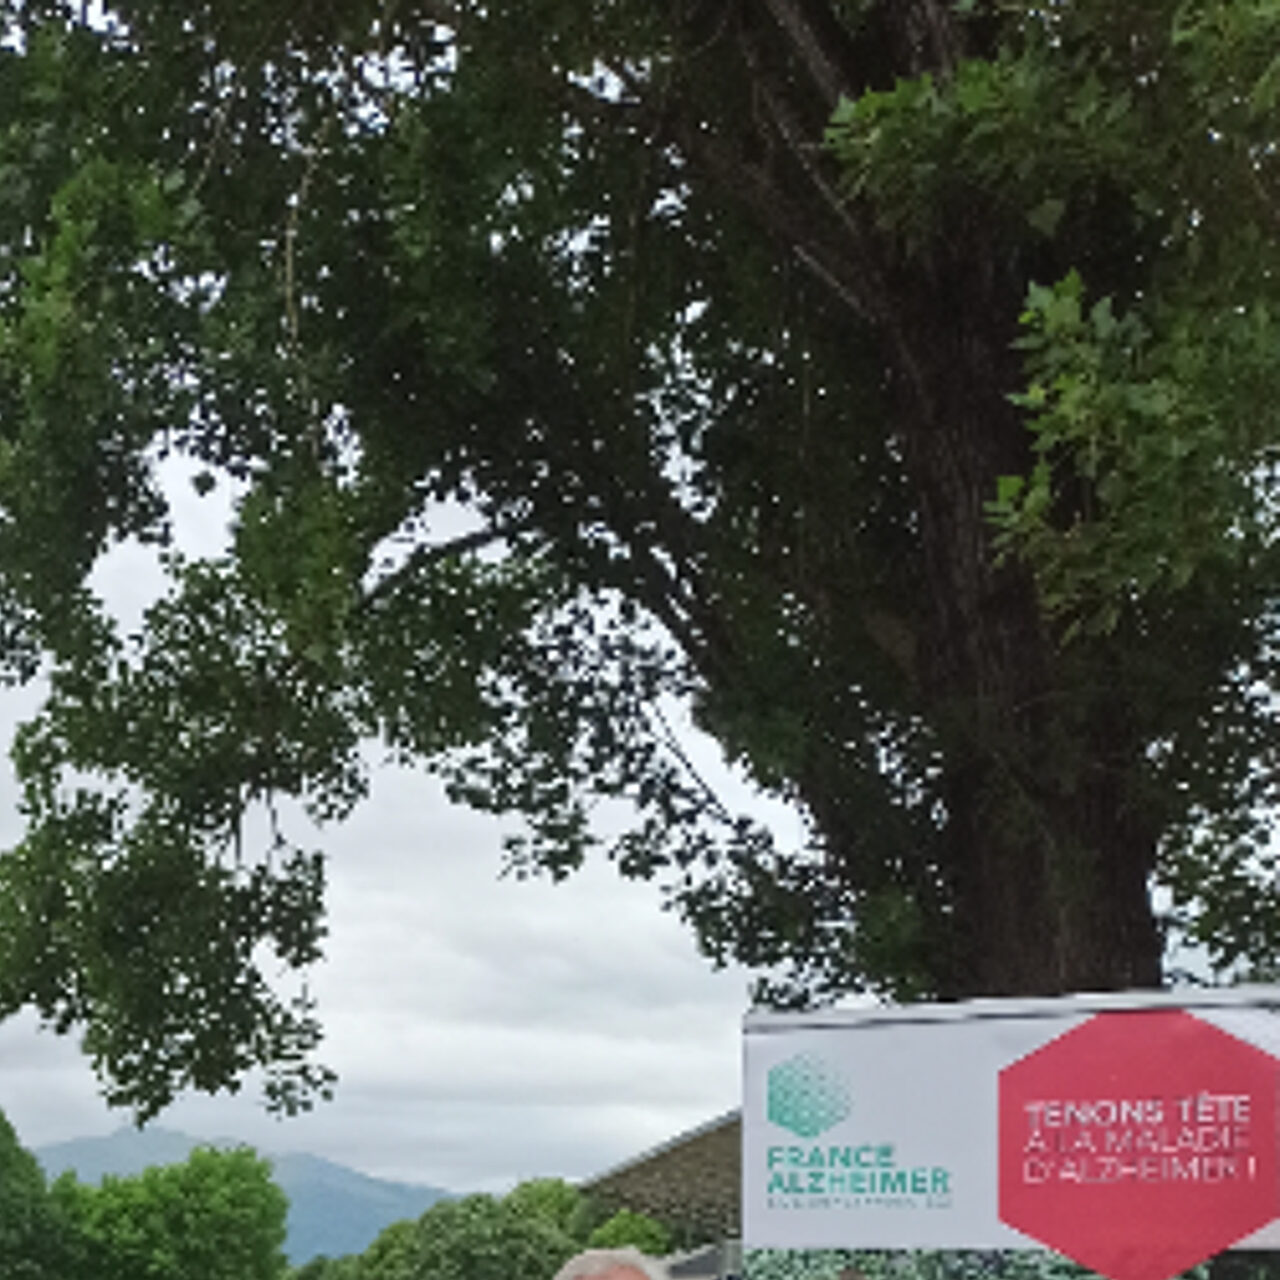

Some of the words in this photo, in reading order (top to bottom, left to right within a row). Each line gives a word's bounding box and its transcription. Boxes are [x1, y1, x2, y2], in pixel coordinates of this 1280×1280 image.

[1024, 1099, 1163, 1127] TENONS
[1180, 1089, 1250, 1122] TÊTE
[1105, 1126, 1250, 1153] MALADIE
[767, 1143, 896, 1169] FRANCE
[767, 1167, 952, 1194] ALZHEIMER
